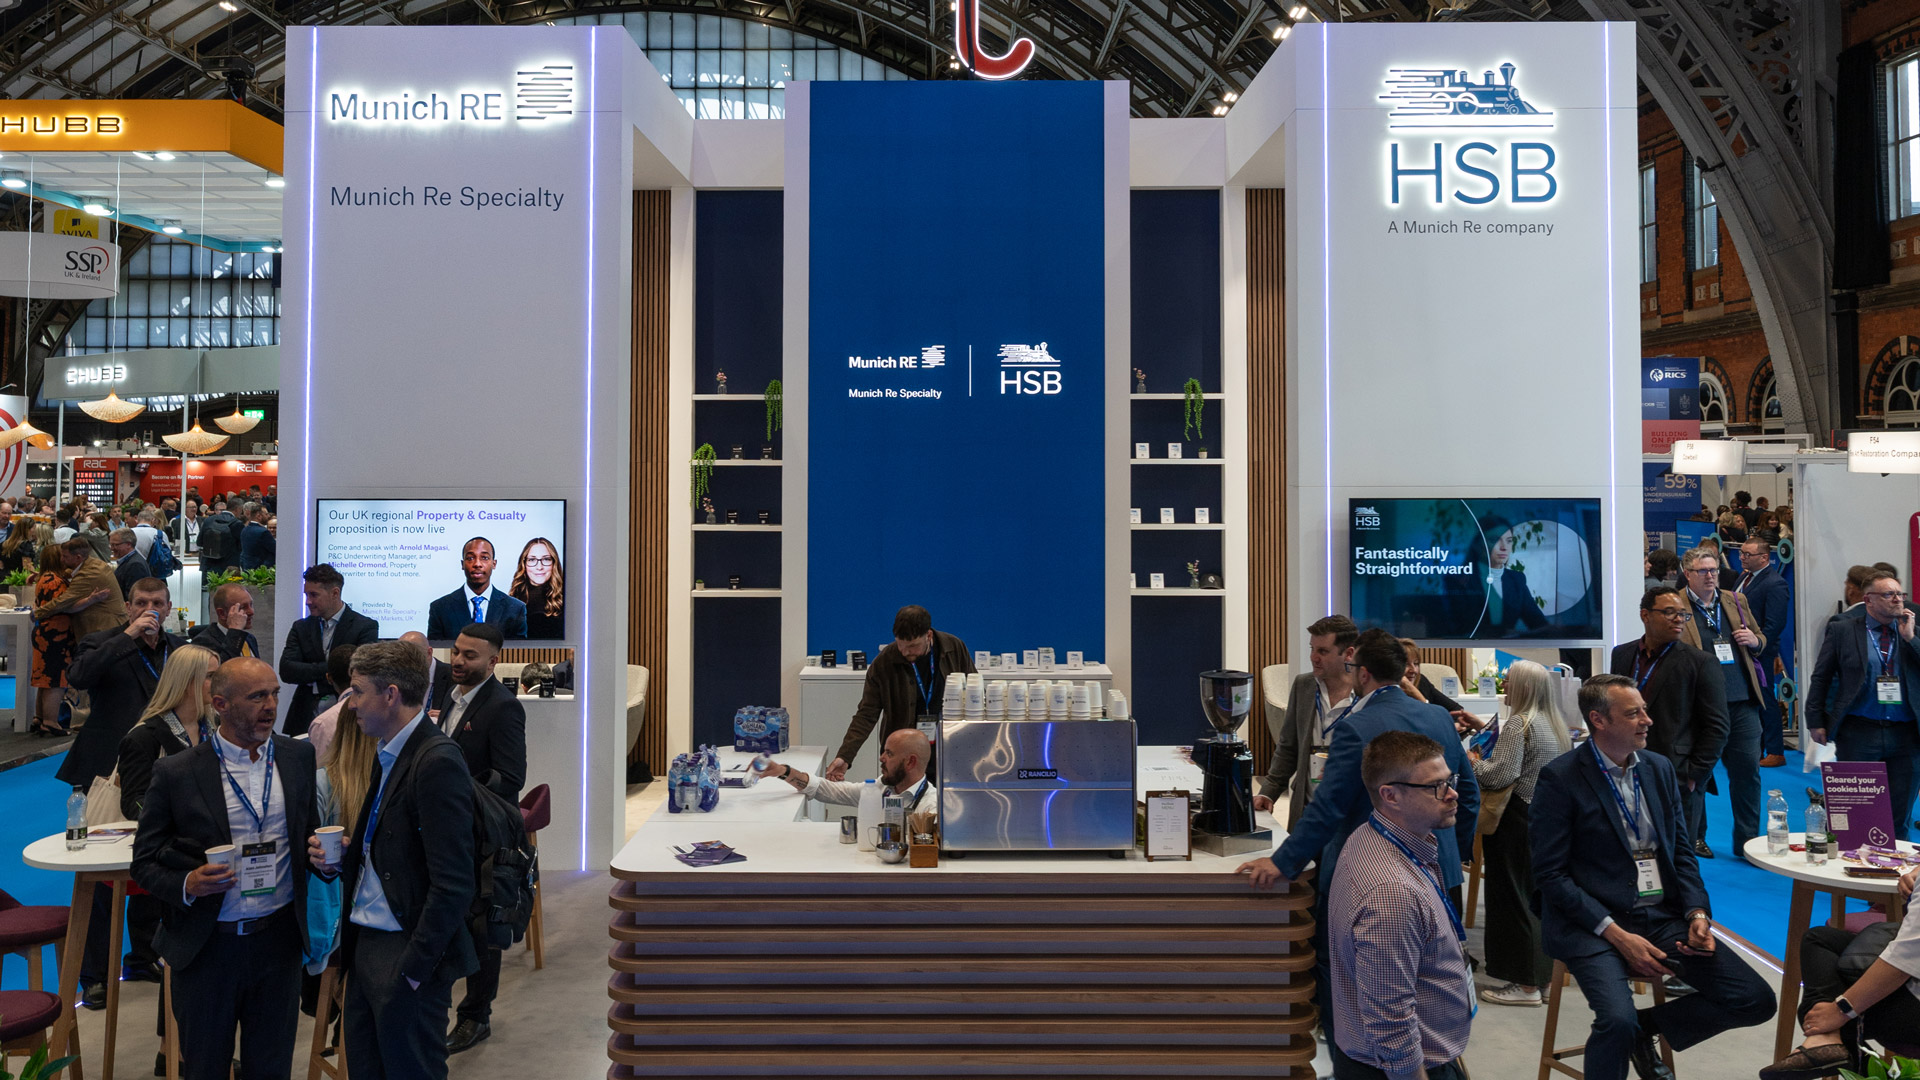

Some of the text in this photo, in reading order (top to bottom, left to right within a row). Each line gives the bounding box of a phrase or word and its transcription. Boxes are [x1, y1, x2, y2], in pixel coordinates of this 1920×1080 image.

[331, 93, 502, 120] Munich RE
[1, 116, 121, 133] HUBB
[1390, 142, 1557, 204] HSB
[331, 186, 565, 211] Munich Re Specialty
[1387, 220, 1554, 236] A Munich Re company
[81, 273, 101, 281] Ireland
[849, 356, 917, 368] Munich RE
[66, 366, 125, 384] CHUBB
[1000, 370, 1062, 395] HSB
[849, 388, 942, 399] Munich Re Specialty
[329, 510, 526, 522] Our UK regional Property & Casualty
[1355, 516, 1380, 526] HSB
[329, 524, 445, 535] proposition is now live
[362, 544, 381, 553] speak
[423, 544, 450, 553] Magasi,
[1355, 546, 1449, 562] Fantastically
[344, 553, 386, 561] Underwriting
[388, 553, 417, 561] Manager,
[389, 562, 416, 570] Property
[1355, 562, 1473, 577] Straightforward
[1825, 775, 1876, 785] Cleared your
[1826, 785, 1886, 794] cookies lately?
[885, 798, 902, 808] MOMA
